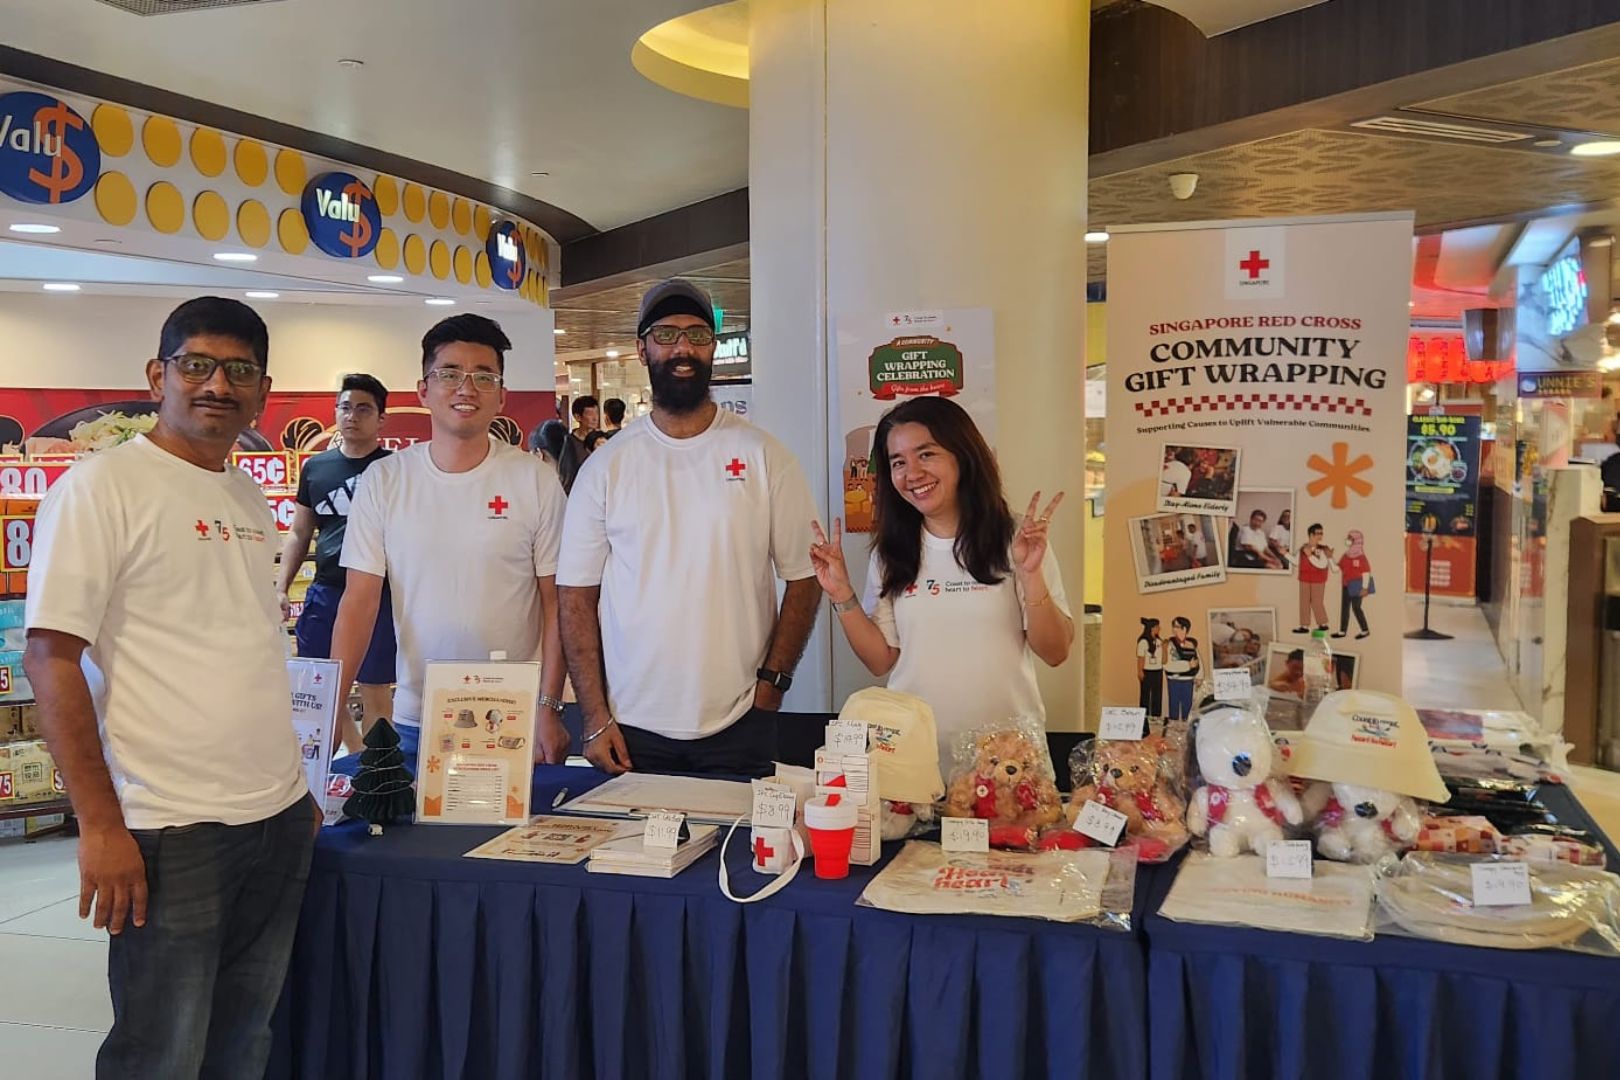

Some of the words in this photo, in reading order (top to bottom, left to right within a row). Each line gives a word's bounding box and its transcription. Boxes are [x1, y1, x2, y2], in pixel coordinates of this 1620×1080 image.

[1150, 317, 1253, 335] SINGAPORE
[1258, 316, 1296, 328] RED
[1301, 316, 1362, 330] CROSS
[902, 351, 928, 361] GIFT
[1150, 337, 1360, 363] COMMUNITY
[884, 360, 947, 371] WRAPPING
[876, 369, 955, 381] CELEBRATION
[1125, 367, 1196, 393] GIFT
[1204, 363, 1387, 389] WRAPPING
[1136, 422, 1185, 434] Supporting
[1187, 420, 1217, 428] Causes
[1229, 418, 1255, 427] Uplift
[1257, 418, 1307, 427] Vulnerable
[1308, 420, 1370, 432] Communities
